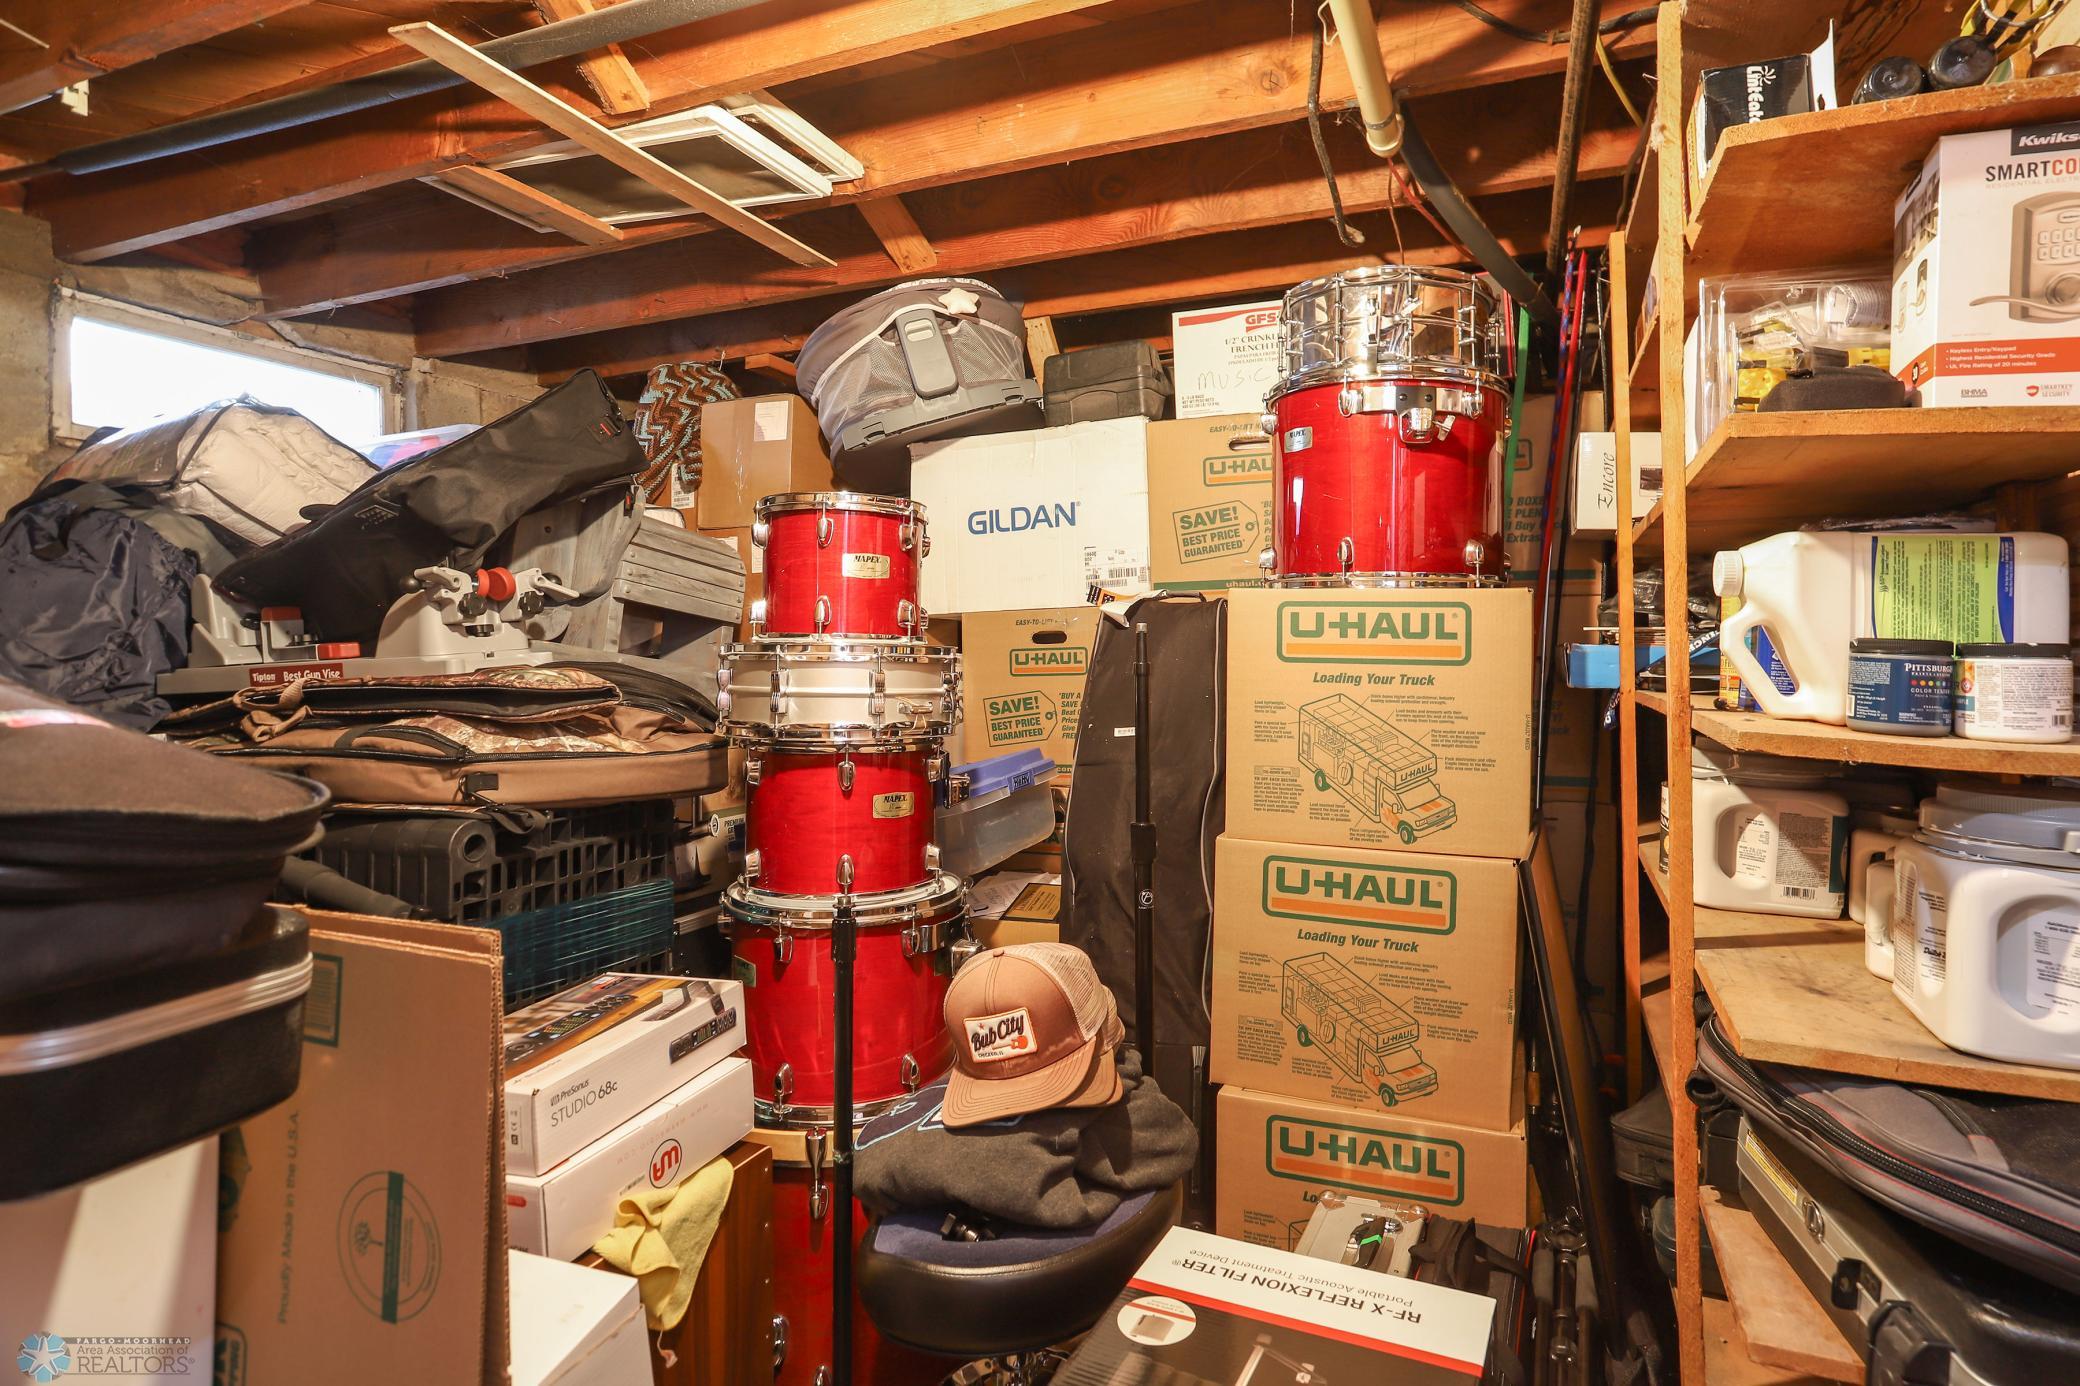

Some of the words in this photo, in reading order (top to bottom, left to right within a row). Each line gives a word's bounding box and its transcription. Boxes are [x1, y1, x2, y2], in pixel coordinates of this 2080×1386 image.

[2019, 133, 2080, 147] Kwiks
[1986, 158, 2080, 182] SMARTCO
[1245, 312, 1277, 325] GFS
[1231, 343, 1268, 353] FRENCH
[1241, 333, 1279, 344] CRINKL
[1198, 368, 1269, 391] MUSIC
[1597, 453, 1616, 509] Encore
[968, 502, 1076, 534] GILDAN
[1180, 506, 1239, 530] SAVE!
[1516, 508, 1541, 518] PLEN
[1183, 534, 1207, 547] BEST
[1210, 529, 1240, 542] PRICE
[1290, 612, 1458, 640] U-HAUL
[1014, 652, 1083, 665] U-HAUL
[1904, 663, 1953, 673] PITTSBURG
[252, 672, 276, 683] Tipton
[284, 671, 301, 682] Best
[304, 670, 320, 679] Gun
[322, 669, 341, 679] Vise
[1312, 672, 1362, 687] Loading
[1367, 673, 1395, 686] Your
[1400, 674, 1435, 686] Truck
[989, 696, 1040, 716] SAVE!
[992, 720, 1013, 732] BEST
[1015, 717, 1041, 728] PRICE
[1401, 765, 1432, 782] U-HAUL
[1276, 867, 1443, 909] U-HAUL
[1297, 929, 1345, 947] Loading
[1351, 934, 1380, 949] Your
[1384, 938, 1419, 953] Truck
[971, 1027, 997, 1052] Bub
[997, 1015, 1024, 1040] City
[1382, 1030, 1416, 1046] U-HAUL
[560, 1079, 590, 1101] PreSonus
[551, 1091, 597, 1127] STUDIO
[598, 1080, 618, 1100] 68c
[1279, 1127, 1450, 1179] U-HAUL
[286, 1164, 297, 1189] the
[286, 1192, 294, 1208] in
[281, 1211, 294, 1258] Made
[1189, 1249, 1225, 1263] Device
[1182, 1258, 1247, 1282] FILTER
[1227, 1260, 1293, 1280] Treatment
[277, 1263, 292, 1324] Proudly
[1251, 1274, 1365, 1310] REFLEXION
[1298, 1273, 1356, 1294] Acoustic
[1357, 1288, 1414, 1307] Portable
[1372, 1302, 1422, 1324] RF-X
